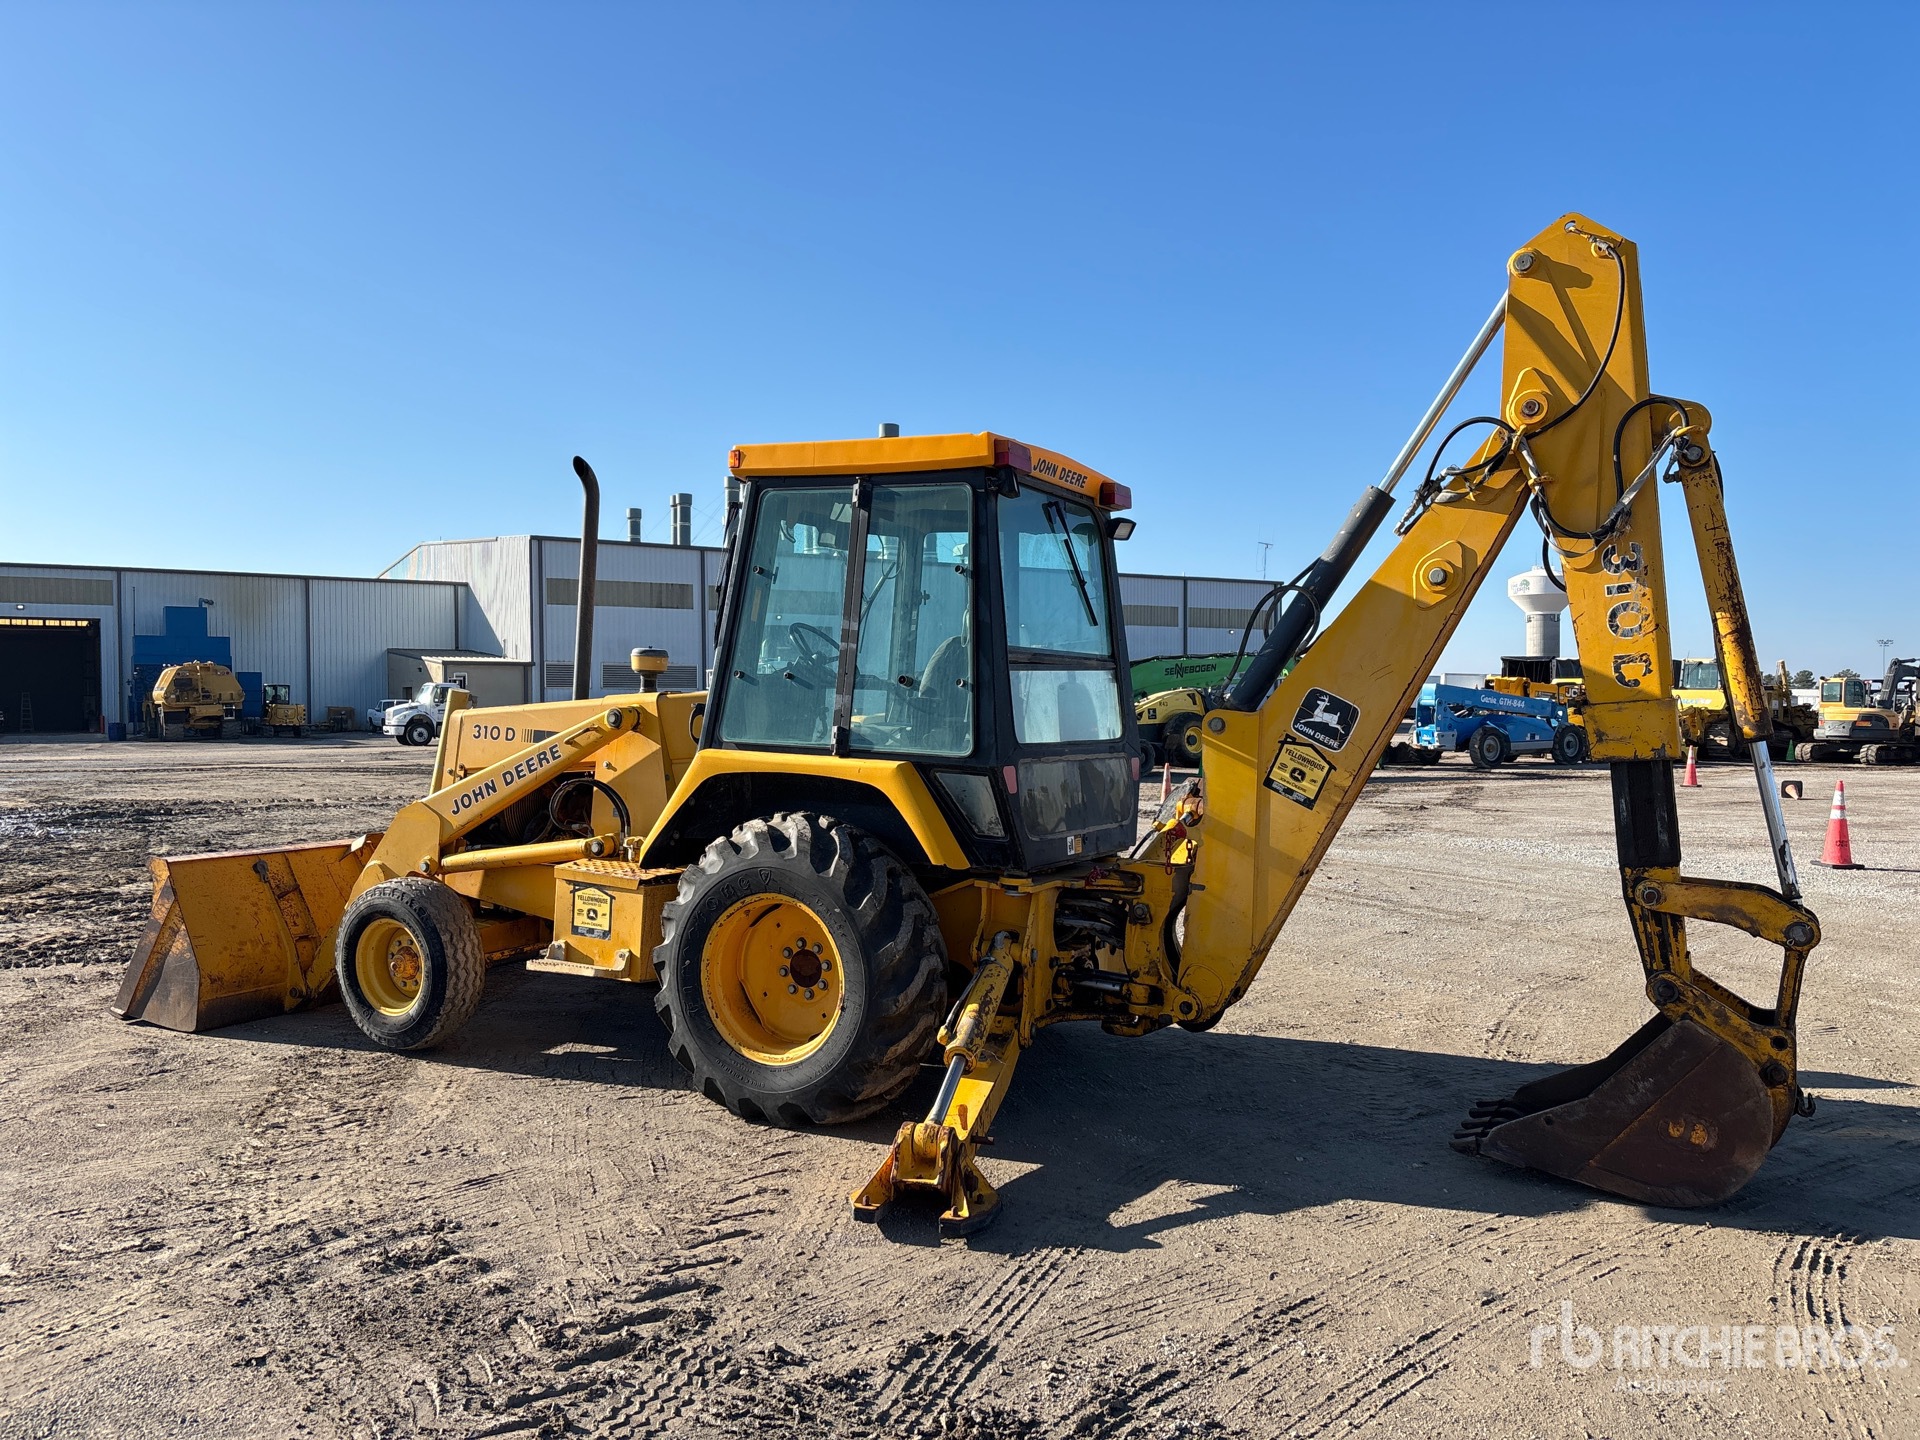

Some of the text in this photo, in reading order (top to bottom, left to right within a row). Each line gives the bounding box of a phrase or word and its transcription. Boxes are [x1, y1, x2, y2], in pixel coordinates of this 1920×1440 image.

[1033, 458, 1088, 488] JOHN DEERE
[1601, 541, 1650, 640] 310
[1164, 663, 1217, 678] SENNEBOGEN
[1480, 694, 1526, 708] Genie GTH-844
[472, 724, 516, 742] 310 D
[1294, 722, 1341, 749] JOHN DEERE
[1284, 747, 1326, 772] YELLOWHOUSE
[450, 743, 562, 815] JOHN DEERE
[577, 894, 609, 904] YELLOWHOUSE
